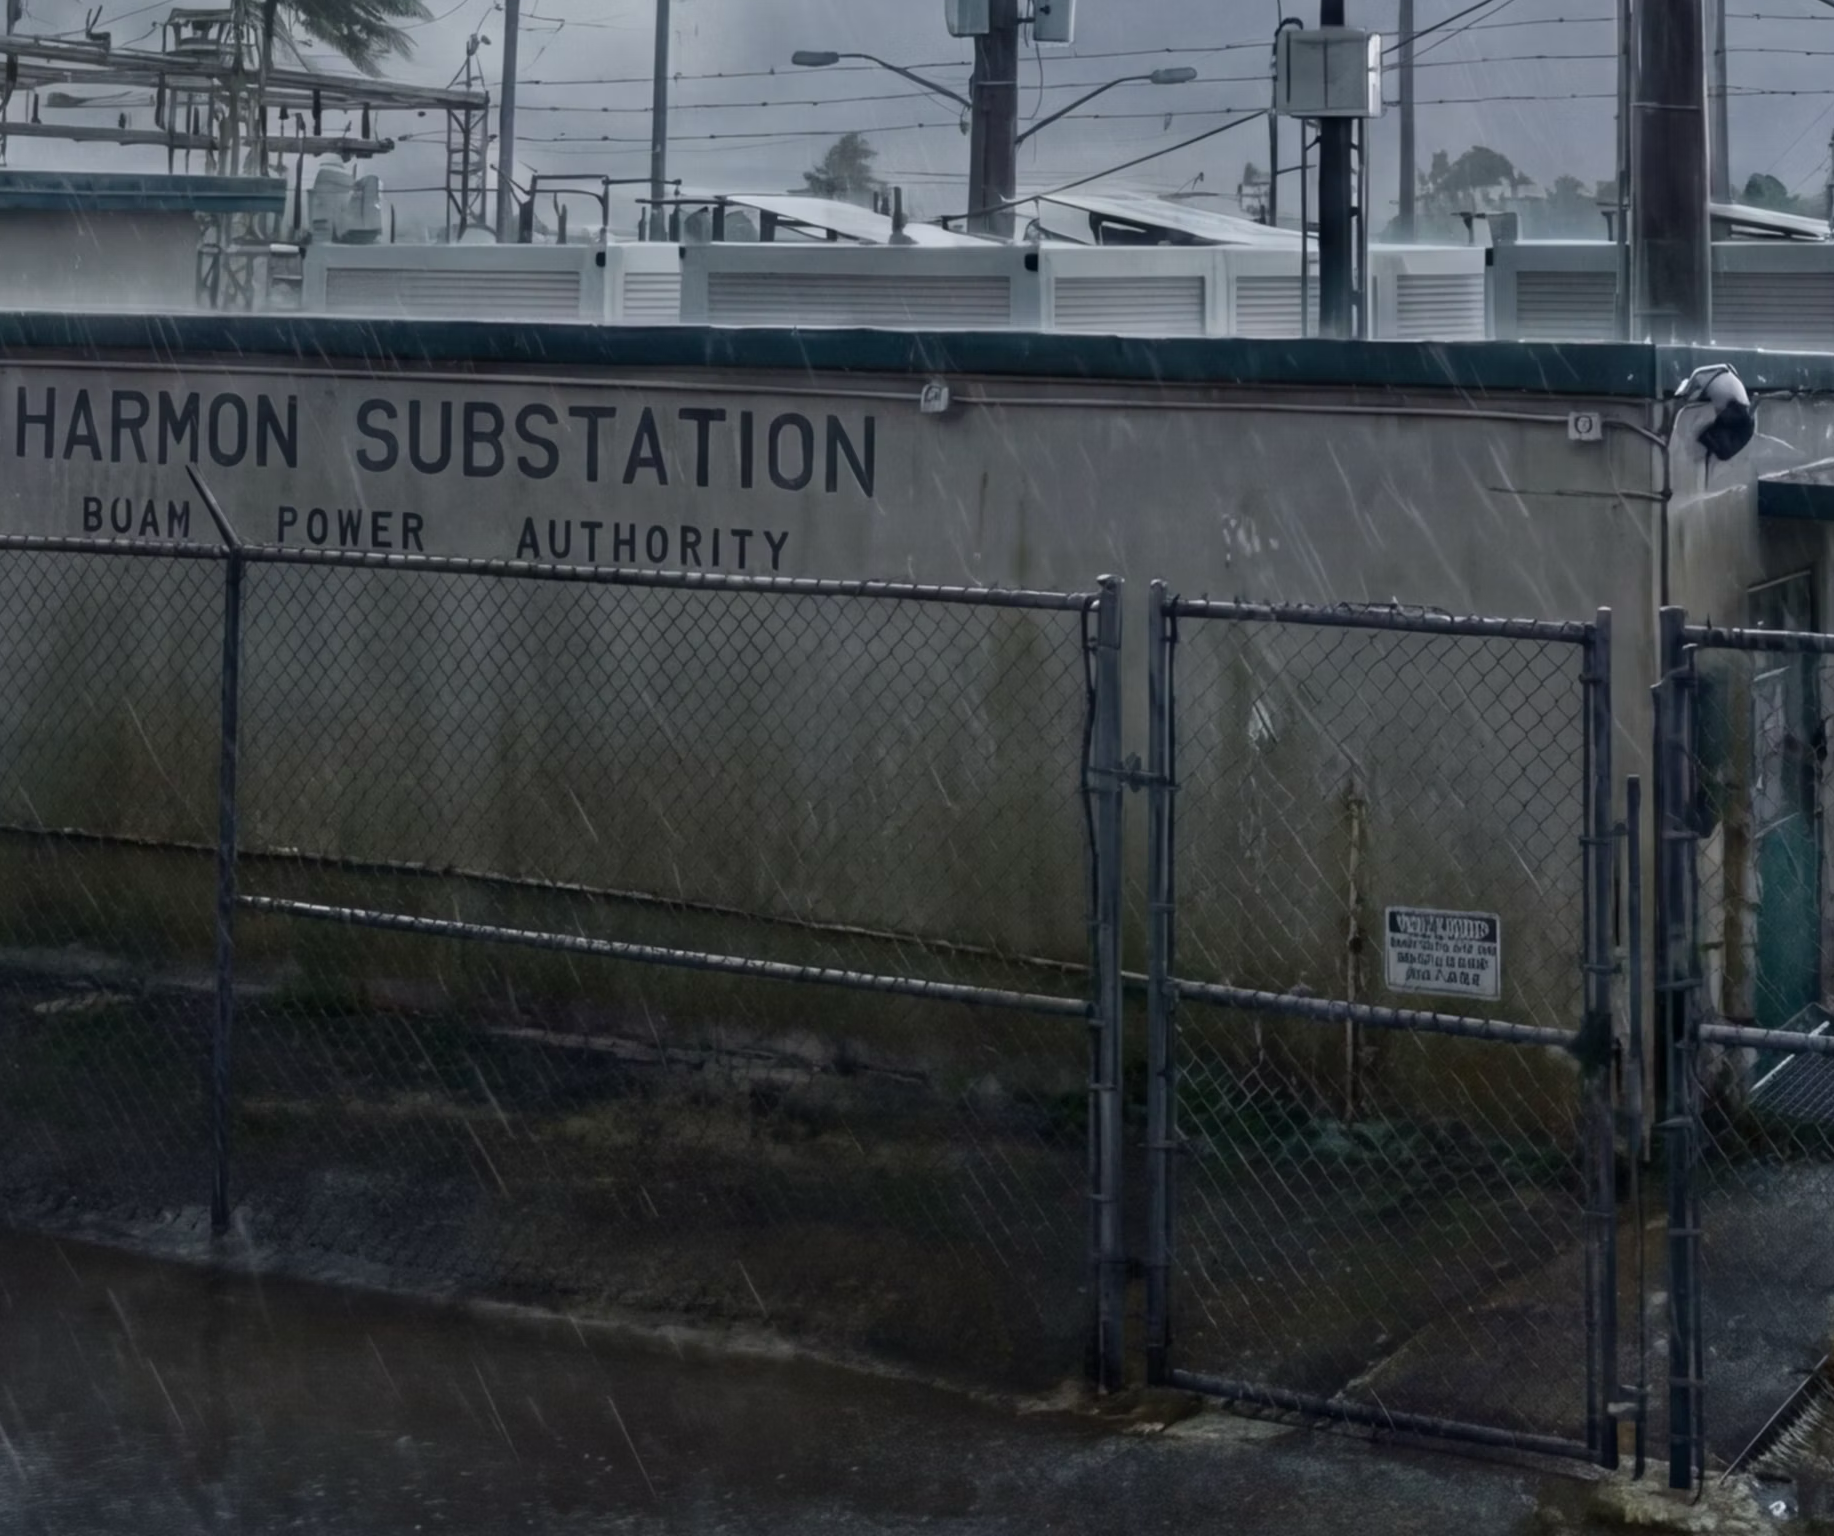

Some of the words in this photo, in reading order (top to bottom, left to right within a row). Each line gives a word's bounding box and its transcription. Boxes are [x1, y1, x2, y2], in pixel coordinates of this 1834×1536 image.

[15, 386, 298, 468] HARMON
[355, 398, 876, 498] SUBSTATION
[277, 505, 424, 552] POWER
[515, 516, 790, 571] AUTHORITY
